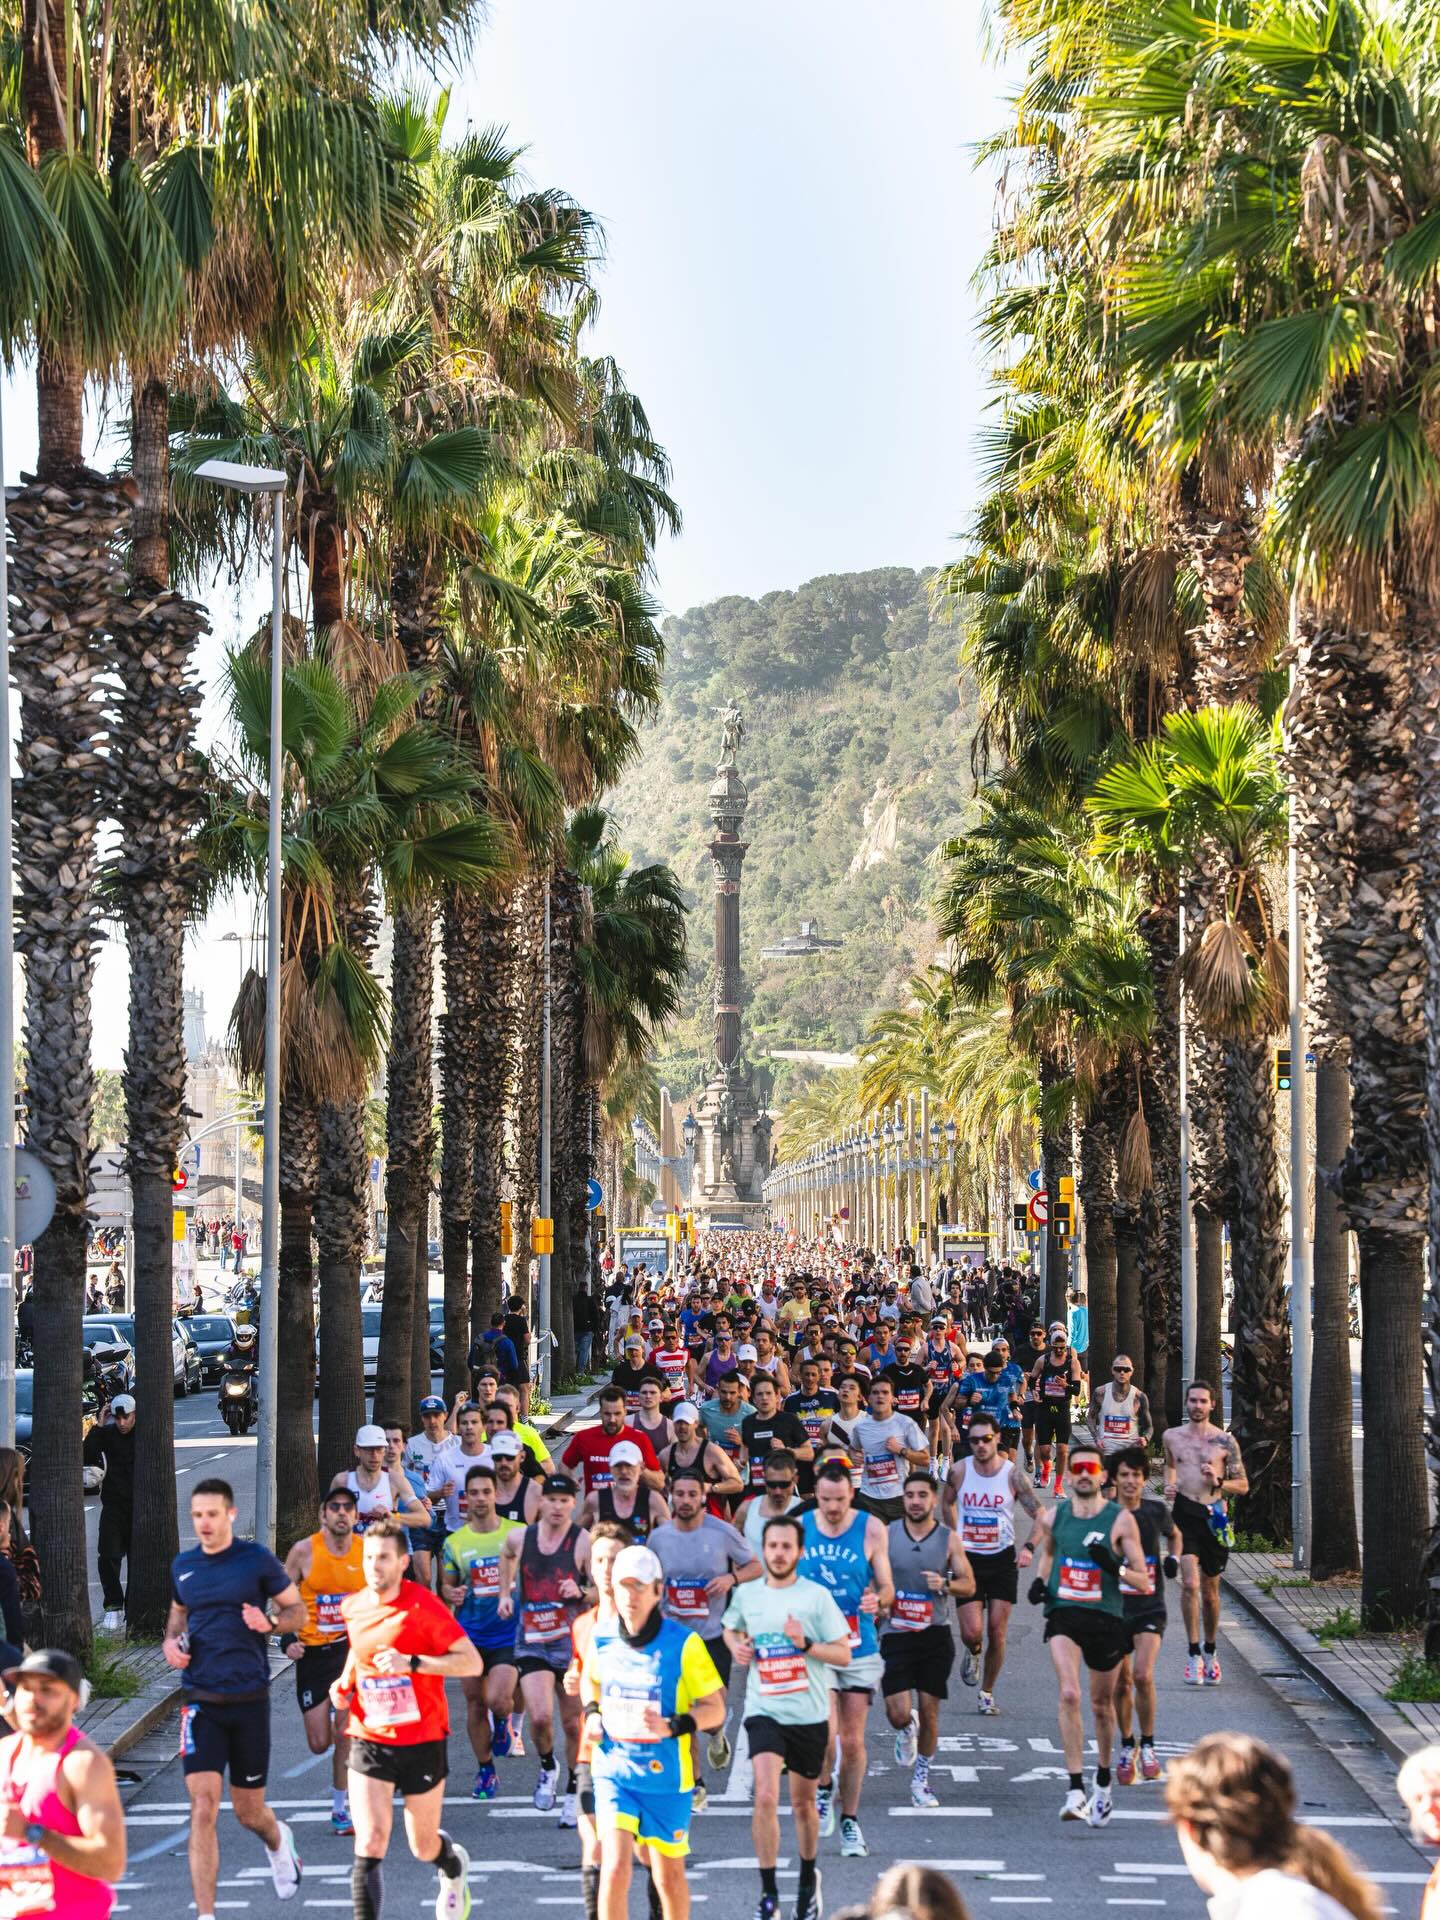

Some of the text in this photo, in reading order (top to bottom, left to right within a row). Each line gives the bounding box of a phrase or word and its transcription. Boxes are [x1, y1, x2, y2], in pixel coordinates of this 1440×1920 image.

[962, 1492, 1004, 1508] MAP
[803, 1543, 859, 1563] FARSLEY
[1069, 1569, 1089, 1582] ALEX
[676, 1589, 695, 1599] GIGI
